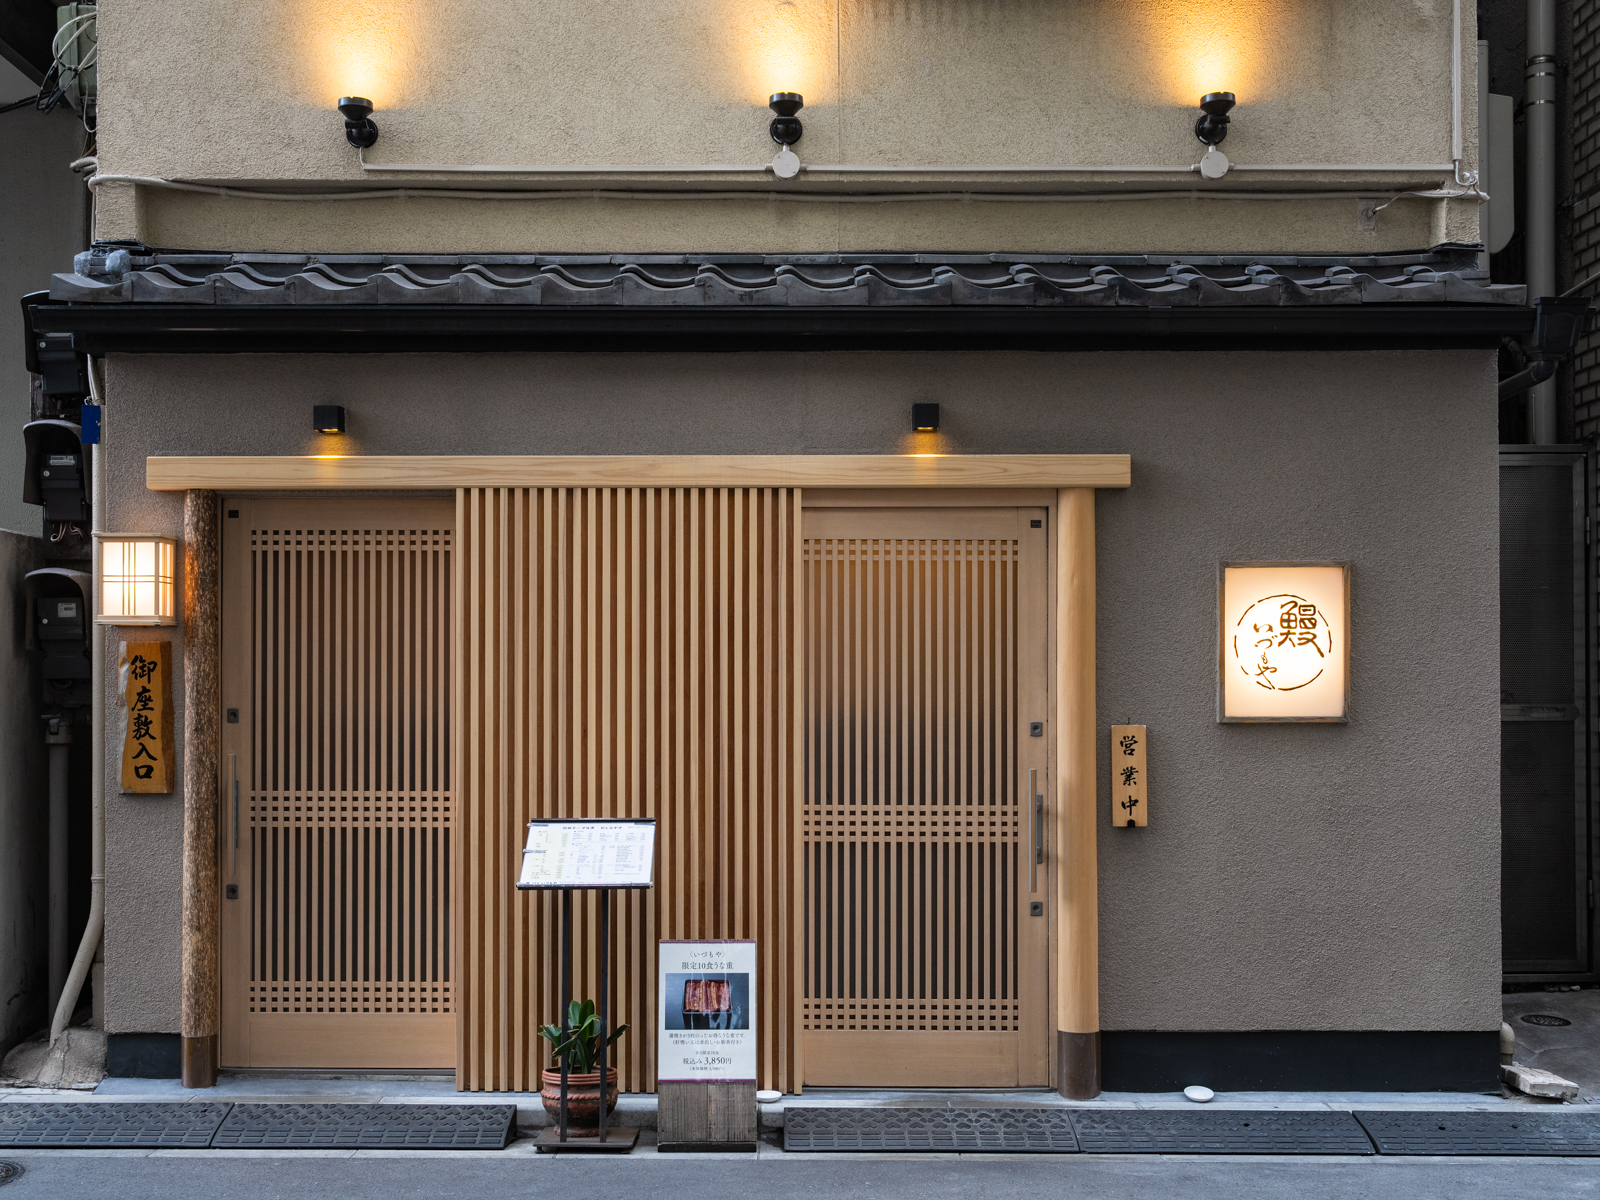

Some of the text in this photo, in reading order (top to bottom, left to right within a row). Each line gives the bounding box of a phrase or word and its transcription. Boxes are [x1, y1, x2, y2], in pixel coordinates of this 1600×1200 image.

[1252, 622, 1278, 690] いづもや
[1277, 600, 1325, 658] 鰻
[130, 654, 158, 780] 御座敷入口
[1119, 734, 1139, 817] 営業中
[681, 961, 734, 971] 限定10食うな重
[682, 1056, 732, 1066] 税込み 3,850円
